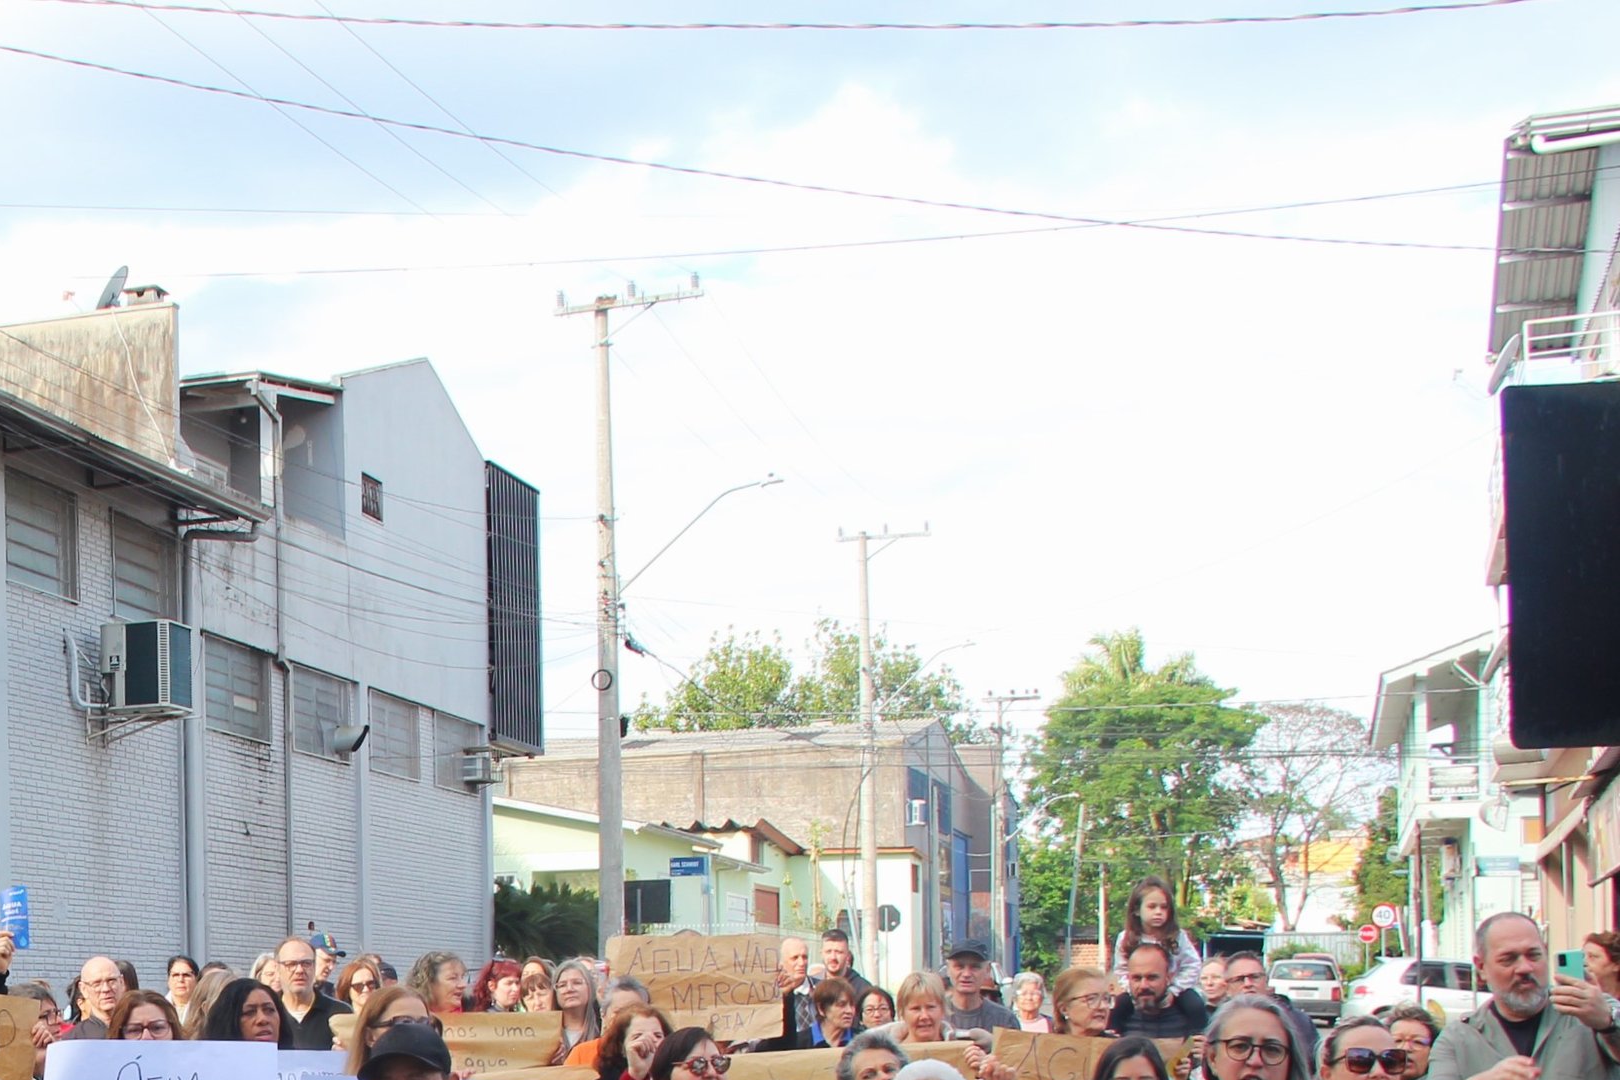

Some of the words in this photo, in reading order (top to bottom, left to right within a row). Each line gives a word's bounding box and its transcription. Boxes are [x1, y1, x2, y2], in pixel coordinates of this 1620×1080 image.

[1376, 909, 1391, 920] 40
[627, 940, 720, 975] ÁGUA
[733, 940, 782, 975] NÃO
[494, 1026, 536, 1038] uma
